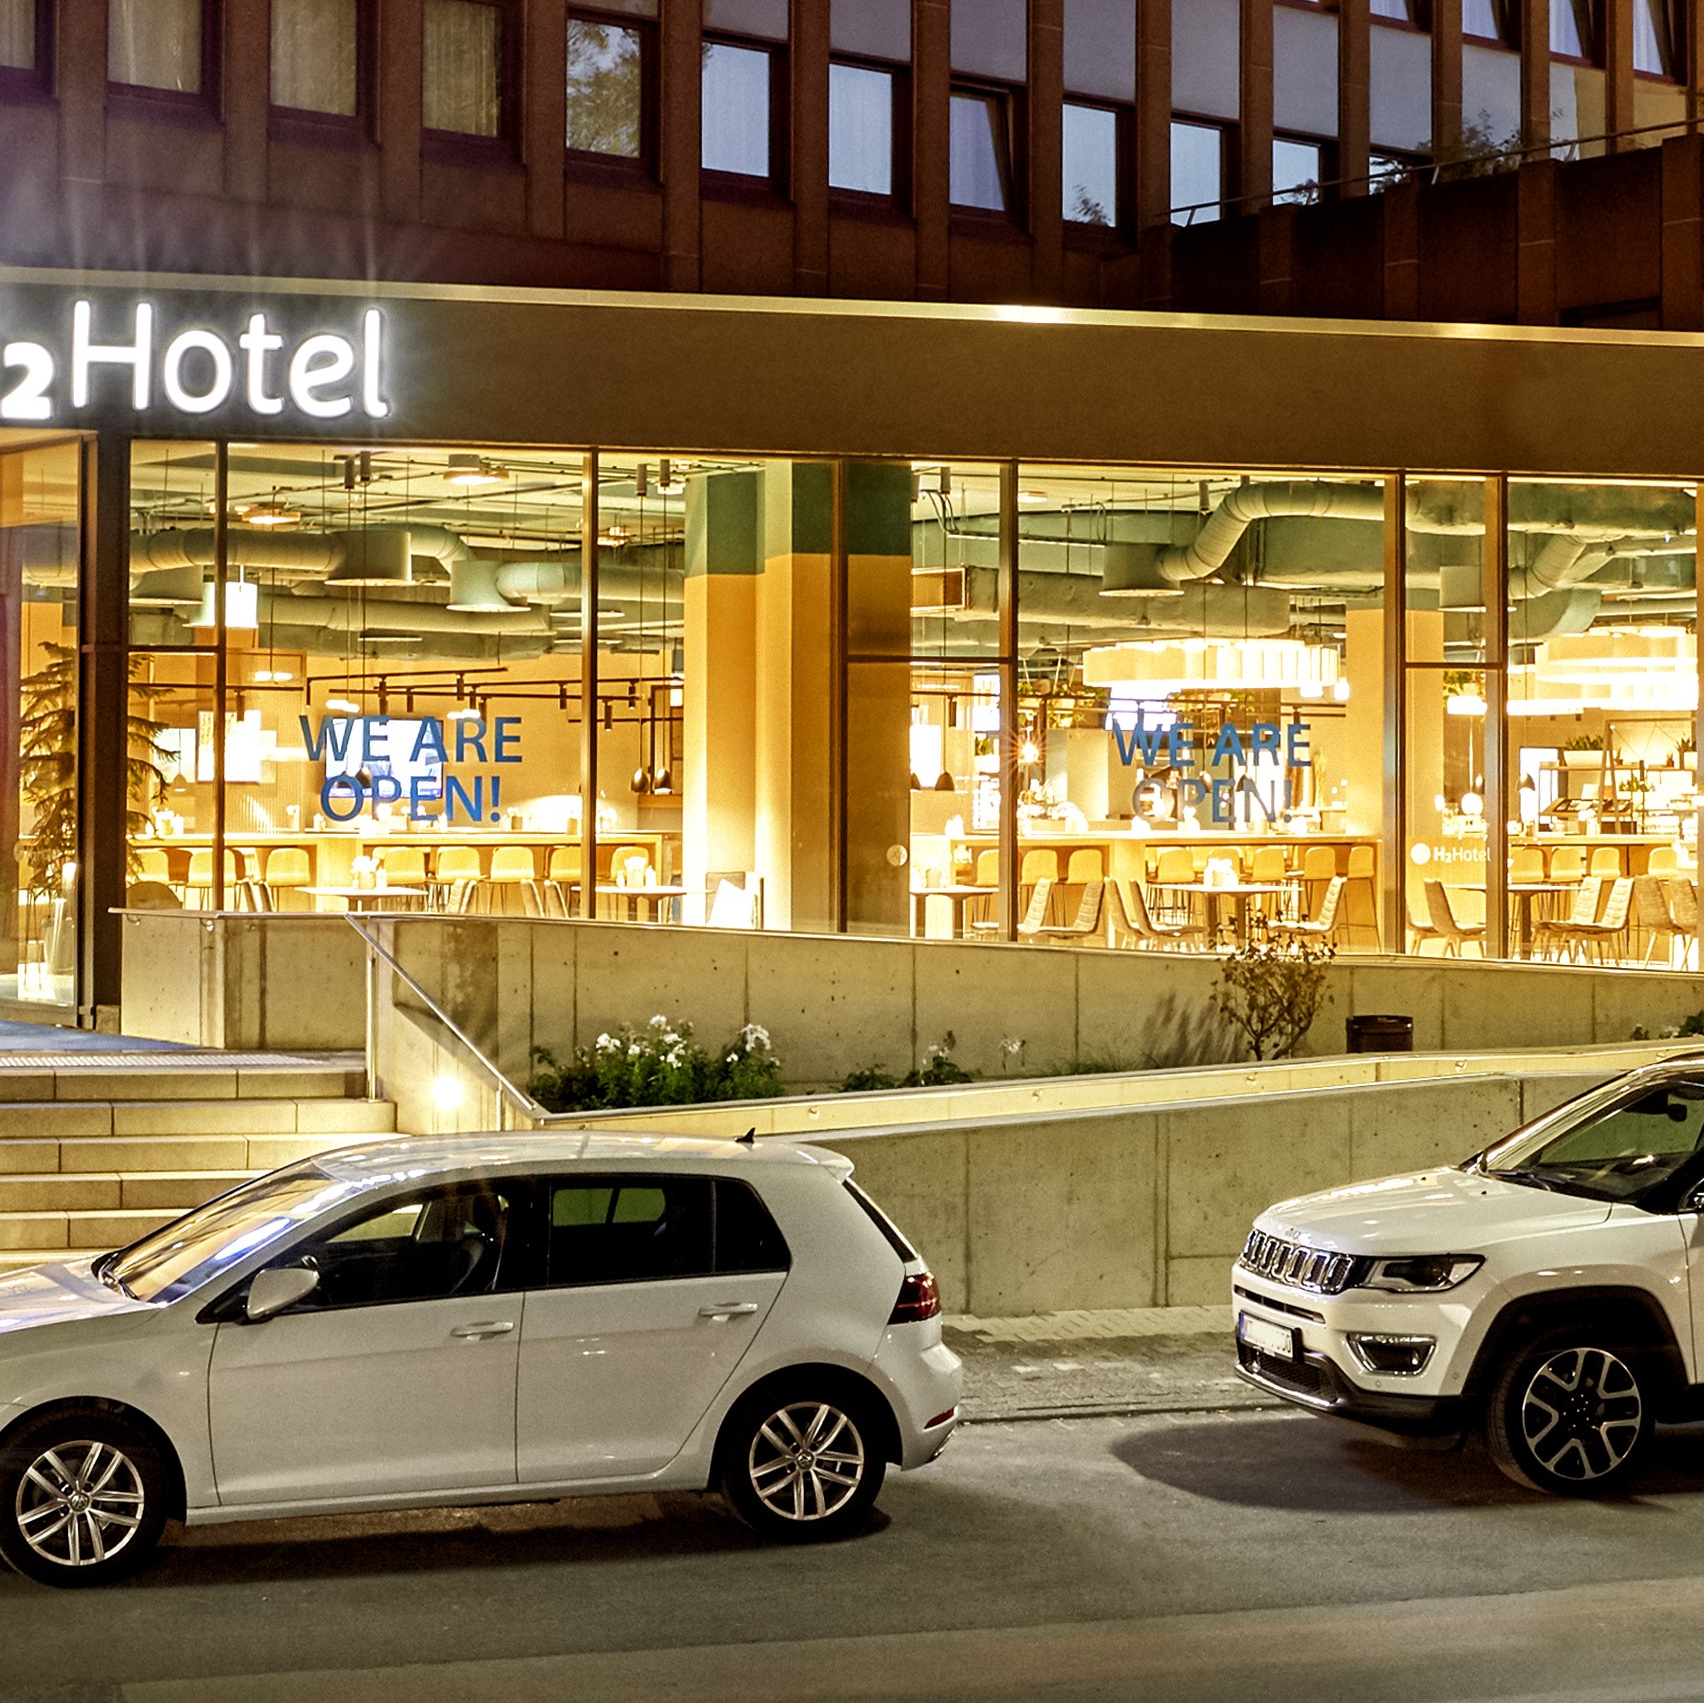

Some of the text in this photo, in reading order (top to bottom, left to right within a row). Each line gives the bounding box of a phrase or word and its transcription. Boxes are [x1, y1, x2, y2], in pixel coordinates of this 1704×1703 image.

[299, 714, 523, 763] WE ARE
[1113, 722, 1311, 767] WE ARE
[321, 774, 501, 822] OPEN!
[1132, 777, 1292, 824] OPEN!
[1433, 846, 1491, 863] H2Hotel
